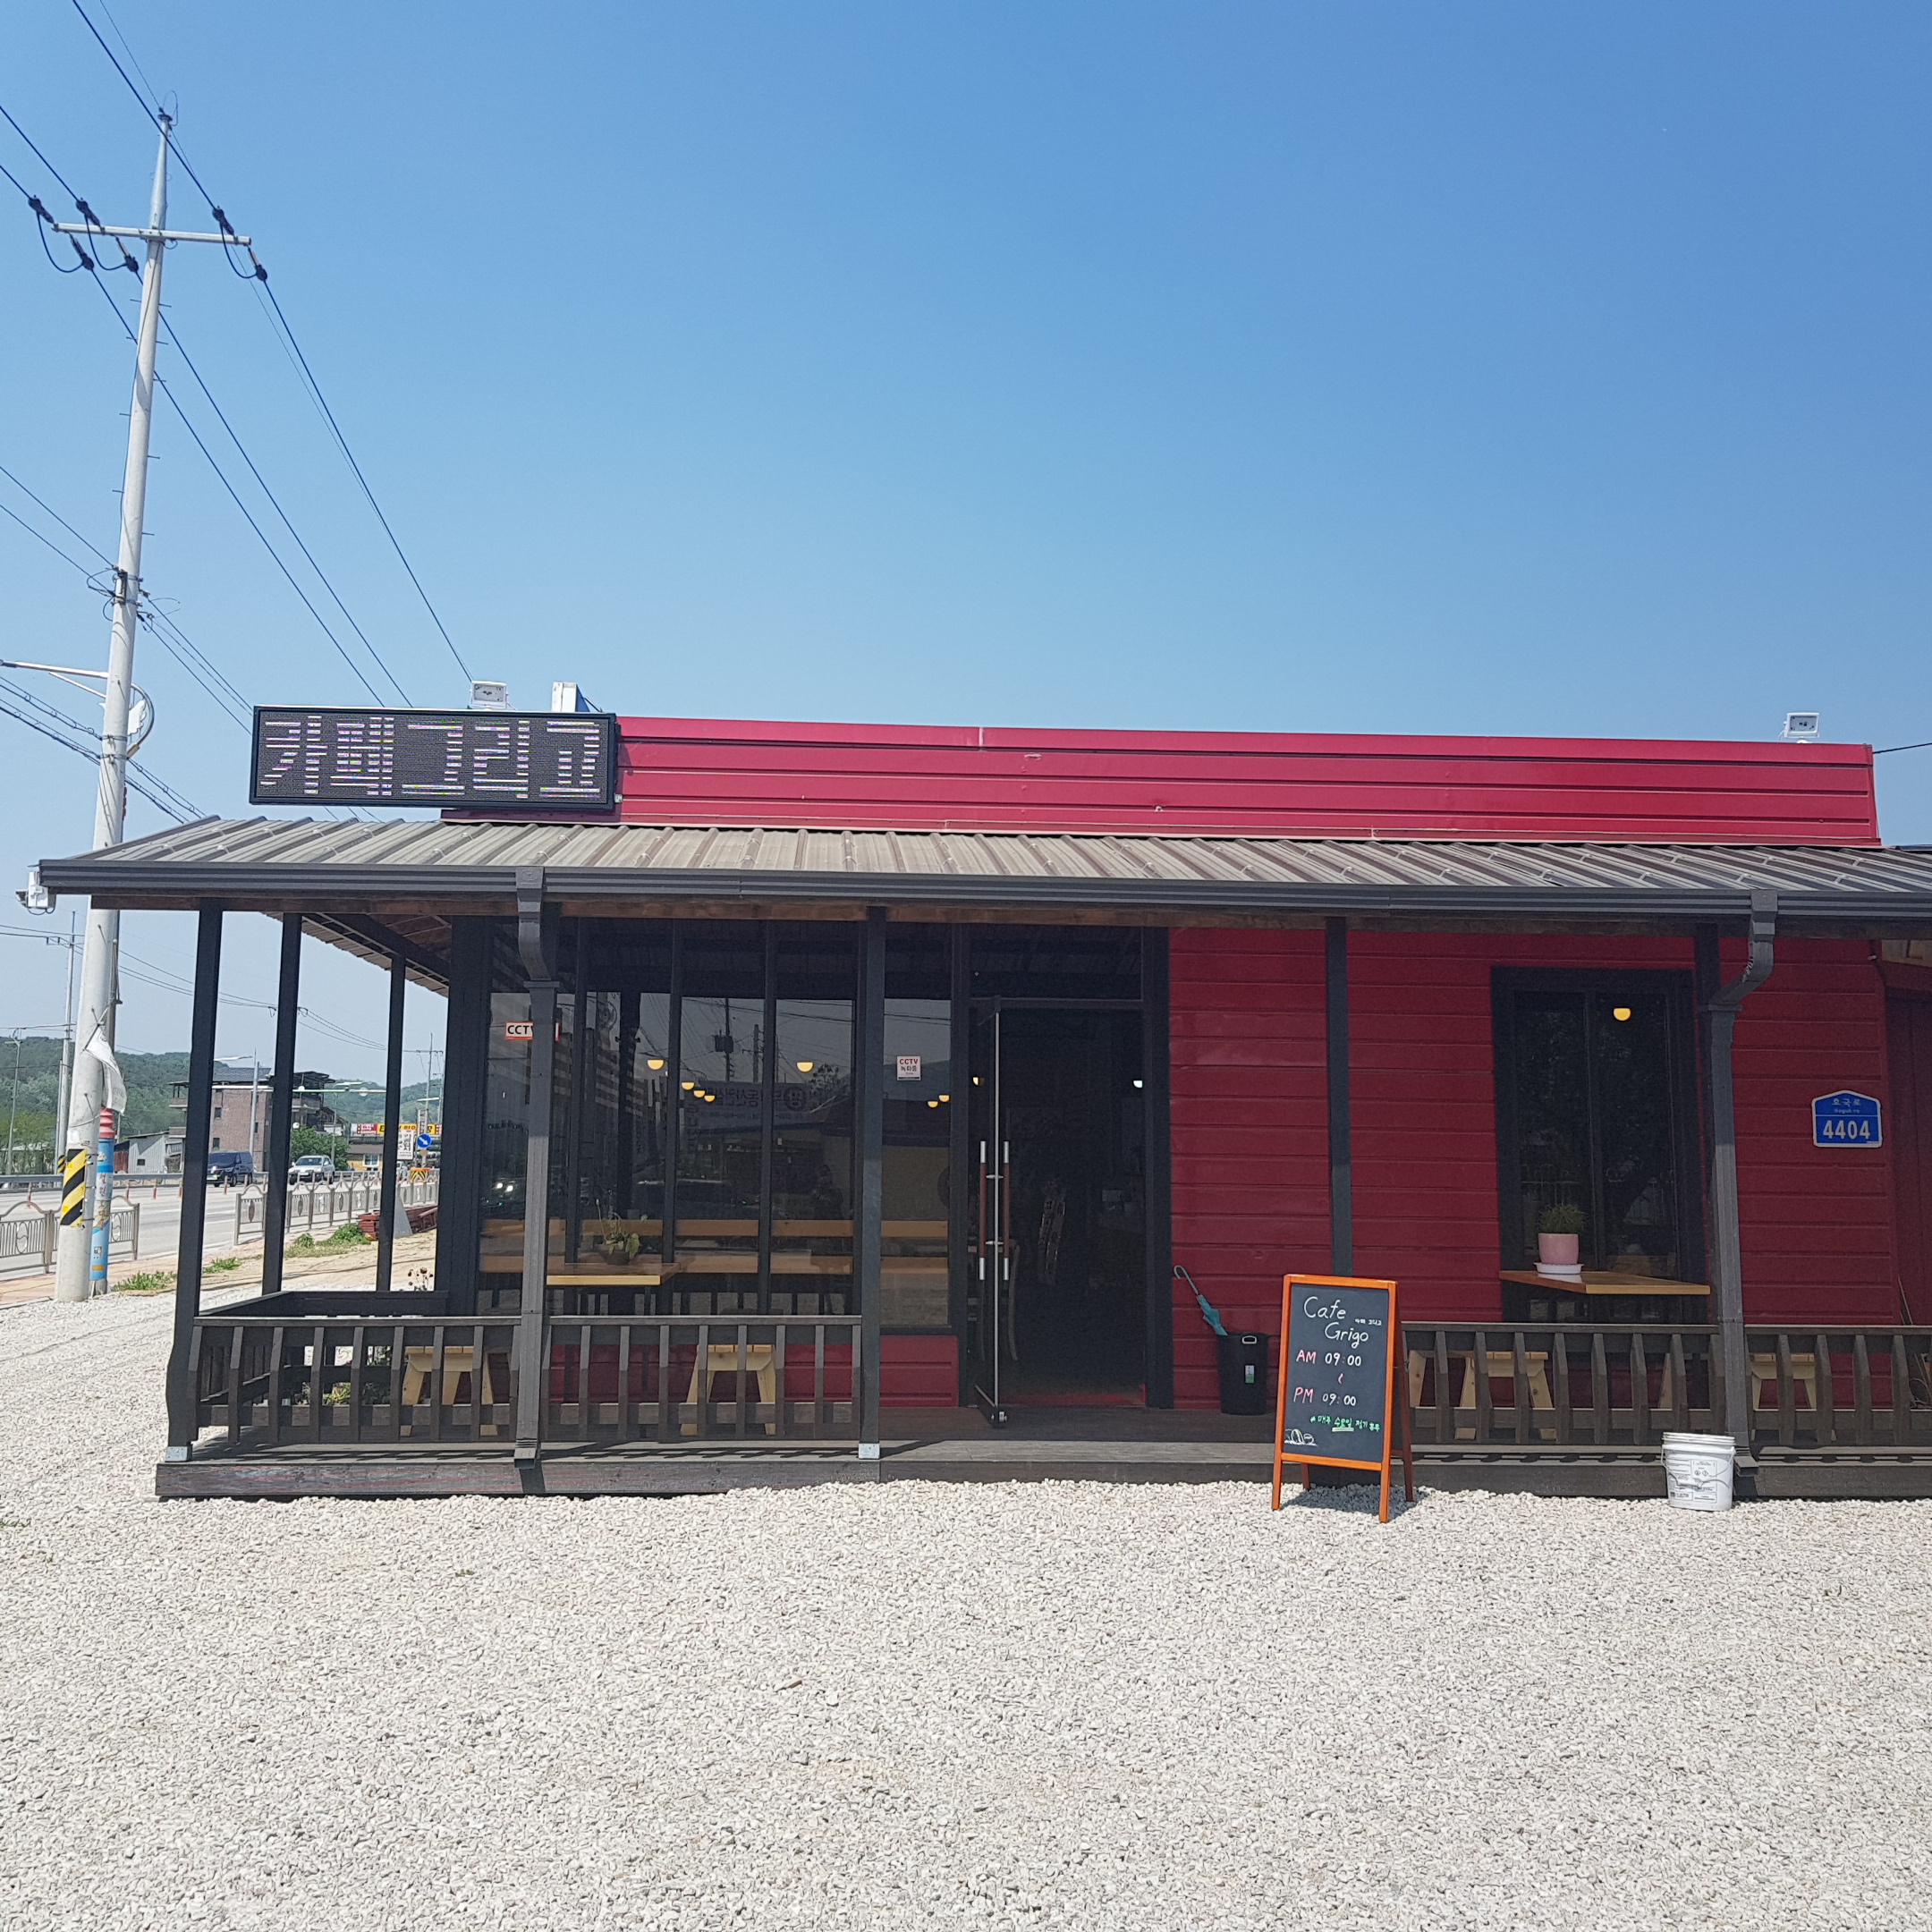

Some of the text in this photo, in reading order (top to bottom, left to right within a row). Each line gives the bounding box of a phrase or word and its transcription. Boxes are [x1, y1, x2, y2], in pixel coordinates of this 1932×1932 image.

[507, 1025, 534, 1035] CCT
[1831, 1097, 1861, 1107] 호국로
[1822, 1120, 1870, 1140] 4404
[1303, 1296, 1347, 1320] Cafe
[1324, 1322, 1369, 1349] Grigo
[1295, 1349, 1361, 1367] AM 09:00
[1292, 1386, 1314, 1404] PM
[1317, 1415, 1331, 1425] 매주
[1334, 1417, 1352, 1428] 수요일
[1355, 1419, 1368, 1429] 정기
